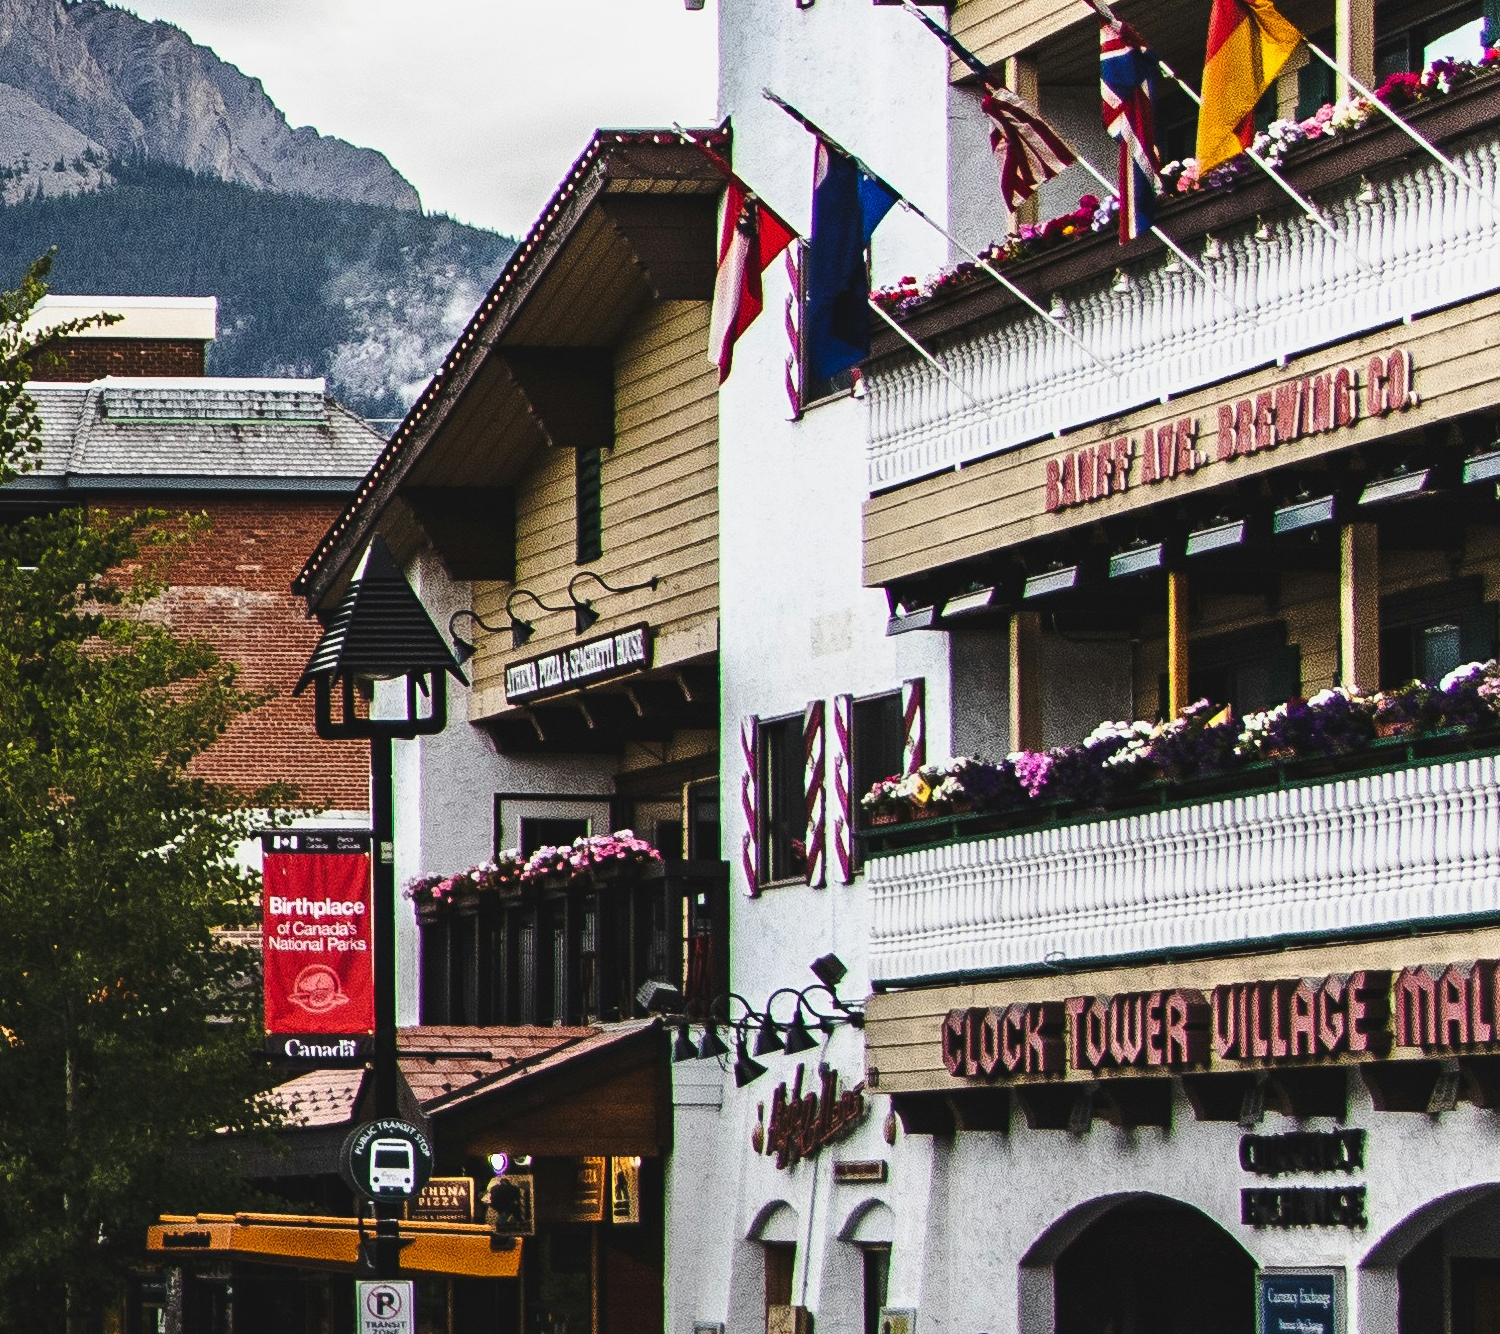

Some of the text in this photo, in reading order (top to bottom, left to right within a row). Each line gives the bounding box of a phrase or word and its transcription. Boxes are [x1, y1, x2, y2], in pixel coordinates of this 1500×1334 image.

[1046, 349, 1422, 513] BANFF AVE. BREWING CO.
[506, 660, 538, 698] ATHENA
[538, 653, 563, 689] PIZZA
[569, 638, 615, 680] SPAGHETTI
[614, 628, 645, 666] HOUSE
[269, 896, 365, 919] Birthplace
[277, 921, 357, 936] of Canada's
[269, 936, 367, 951] National Parks
[941, 999, 1050, 1078] CLOCK
[1064, 990, 1192, 1070] TOWER
[1210, 970, 1368, 1060] VILLAGE
[284, 1039, 356, 1058] Canada
[354, 1120, 431, 1157] PUBLIC TRANSIT STOP
[420, 1186, 468, 1196] THENA
[418, 1196, 459, 1206] PIZZA
[365, 1320, 407, 1329] TRANSIT
